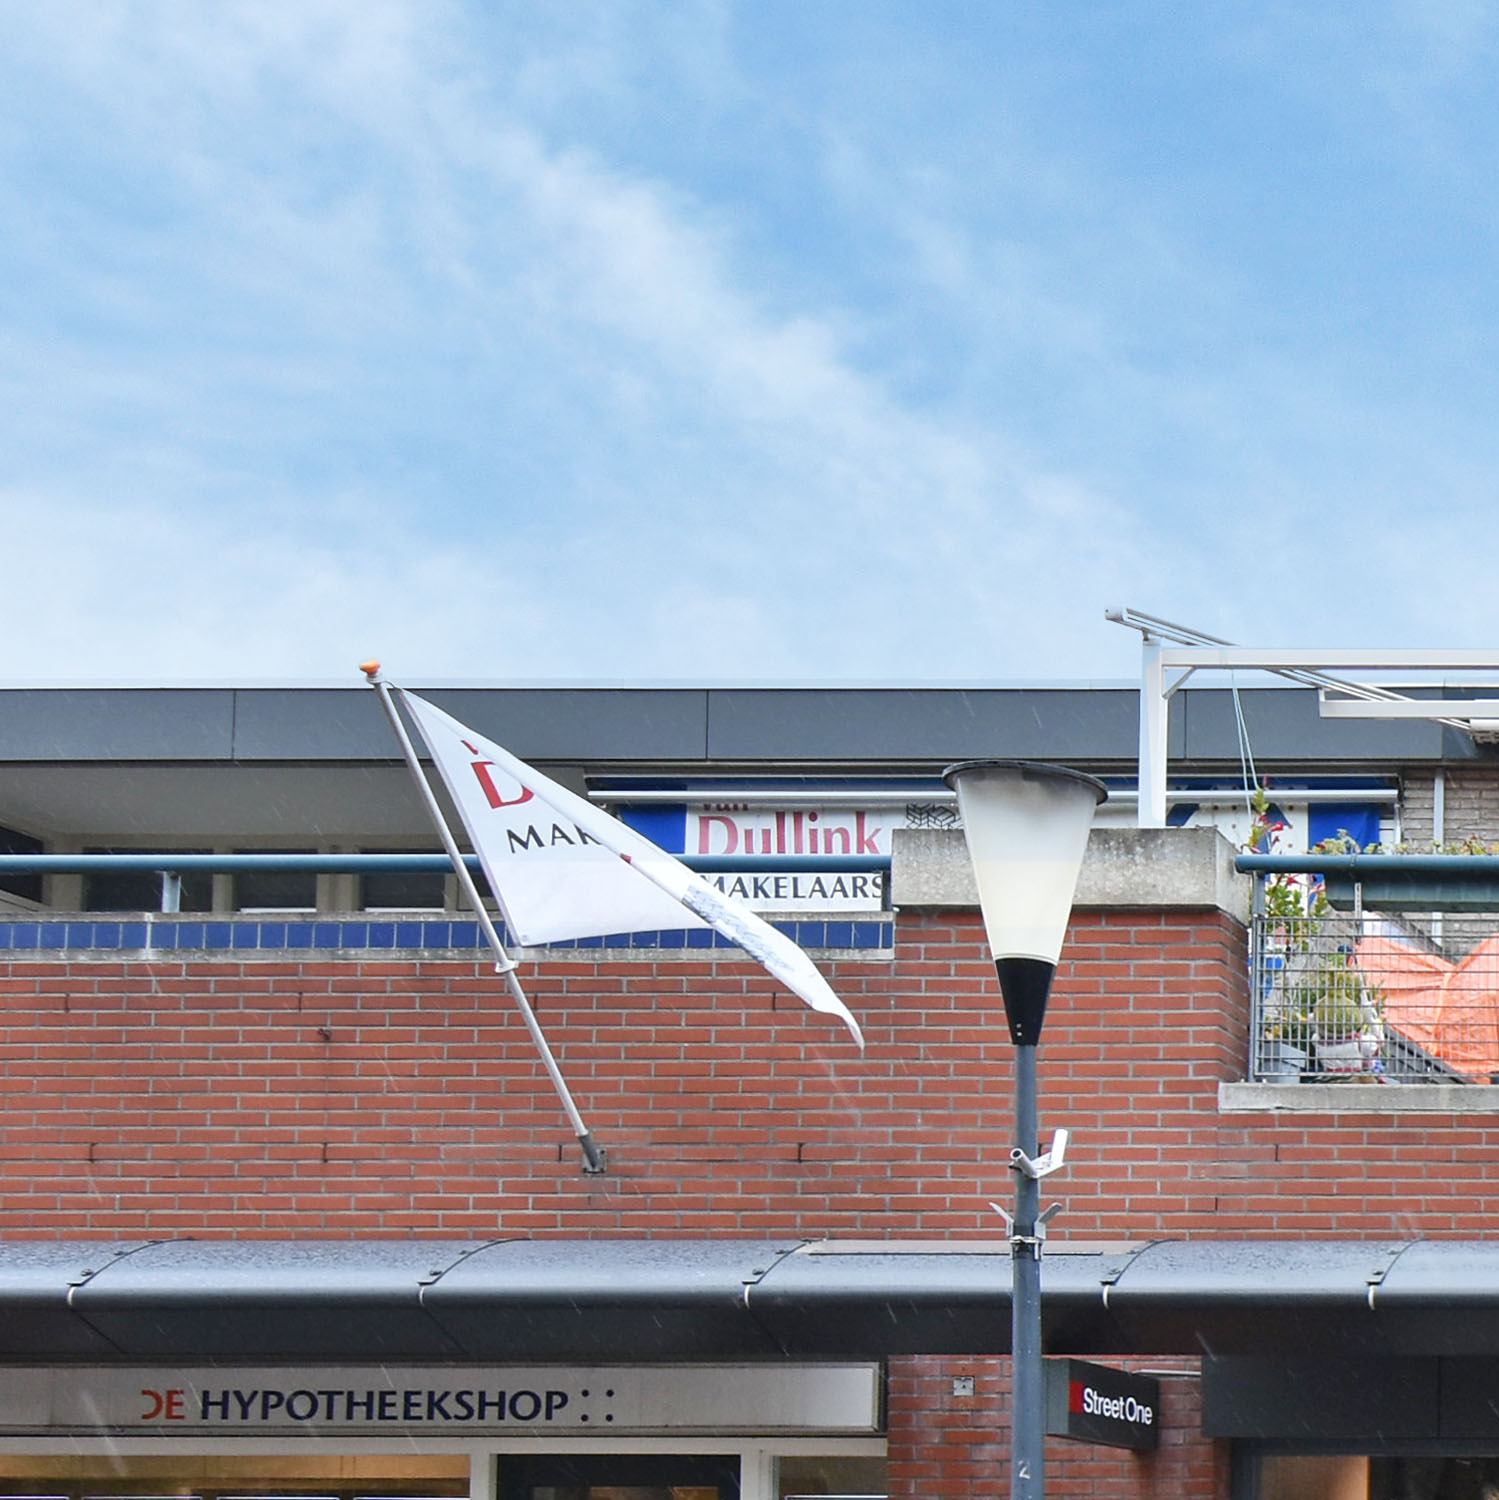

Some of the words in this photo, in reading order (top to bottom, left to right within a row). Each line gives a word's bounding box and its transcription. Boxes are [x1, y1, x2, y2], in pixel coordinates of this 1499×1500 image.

[698, 811, 881, 854] Dullink
[200, 1389, 569, 1421] HYPOTHEEKSHOP
[1083, 1387, 1125, 1420] Street
[1125, 1396, 1153, 1425] One
